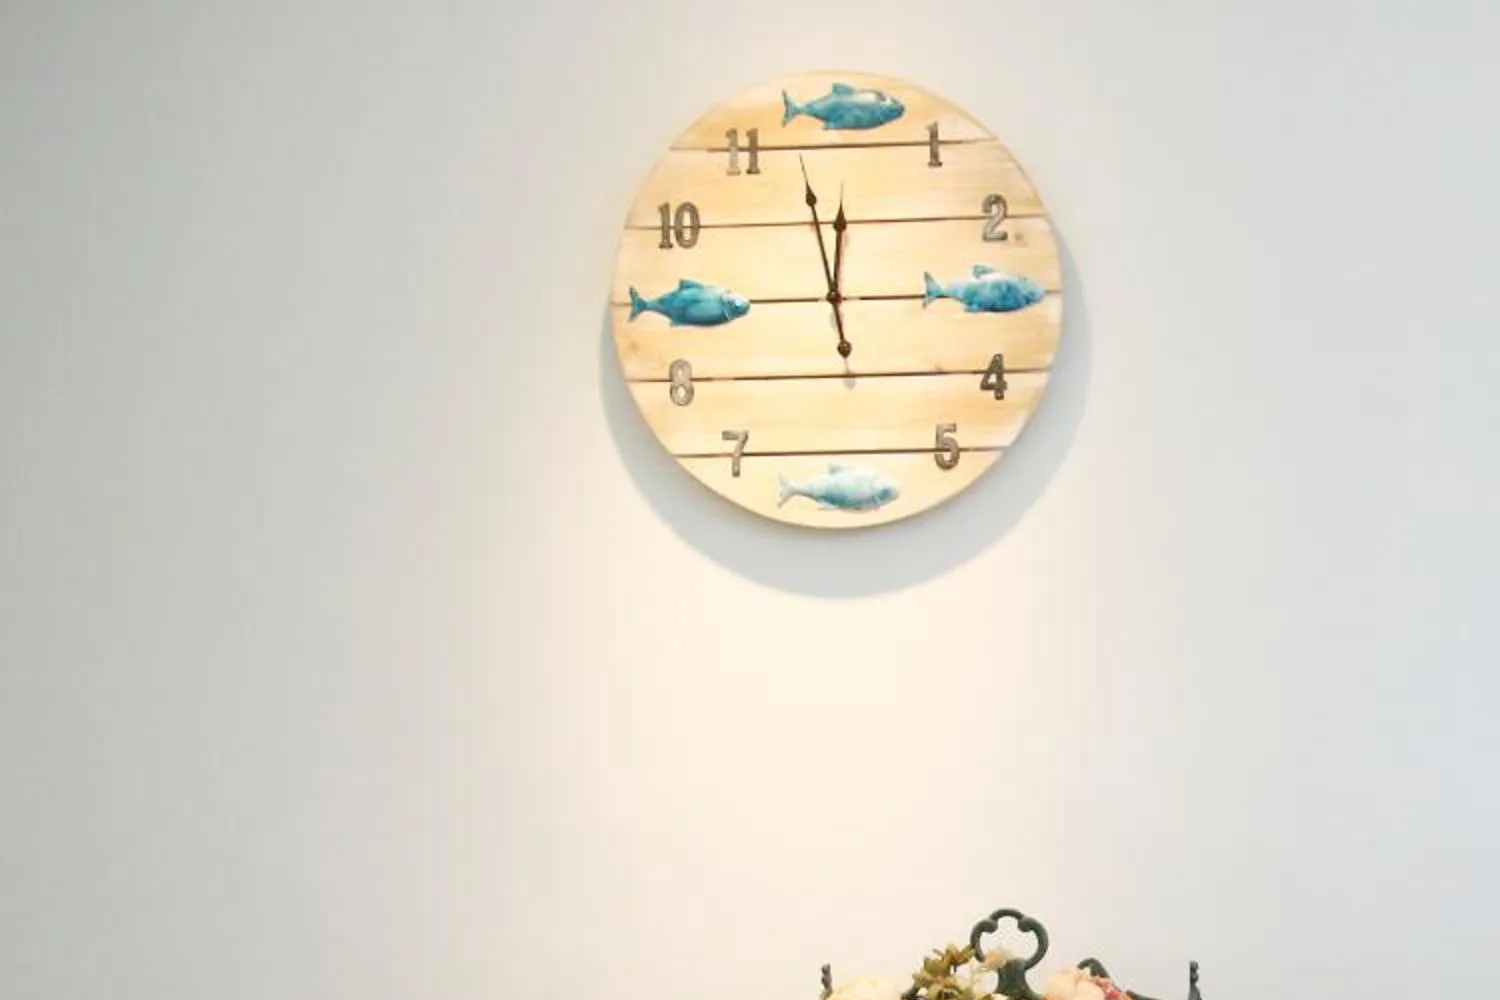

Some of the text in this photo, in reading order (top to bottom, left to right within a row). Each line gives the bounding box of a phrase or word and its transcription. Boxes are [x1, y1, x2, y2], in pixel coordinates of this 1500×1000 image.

[725, 128, 760, 175] 11
[928, 122, 943, 167] 1
[658, 202, 701, 249] 10
[981, 193, 1009, 242] 2
[668, 358, 695, 407] 8
[980, 353, 1008, 400] 4
[721, 429, 749, 478] 7
[933, 422, 961, 470] 5
